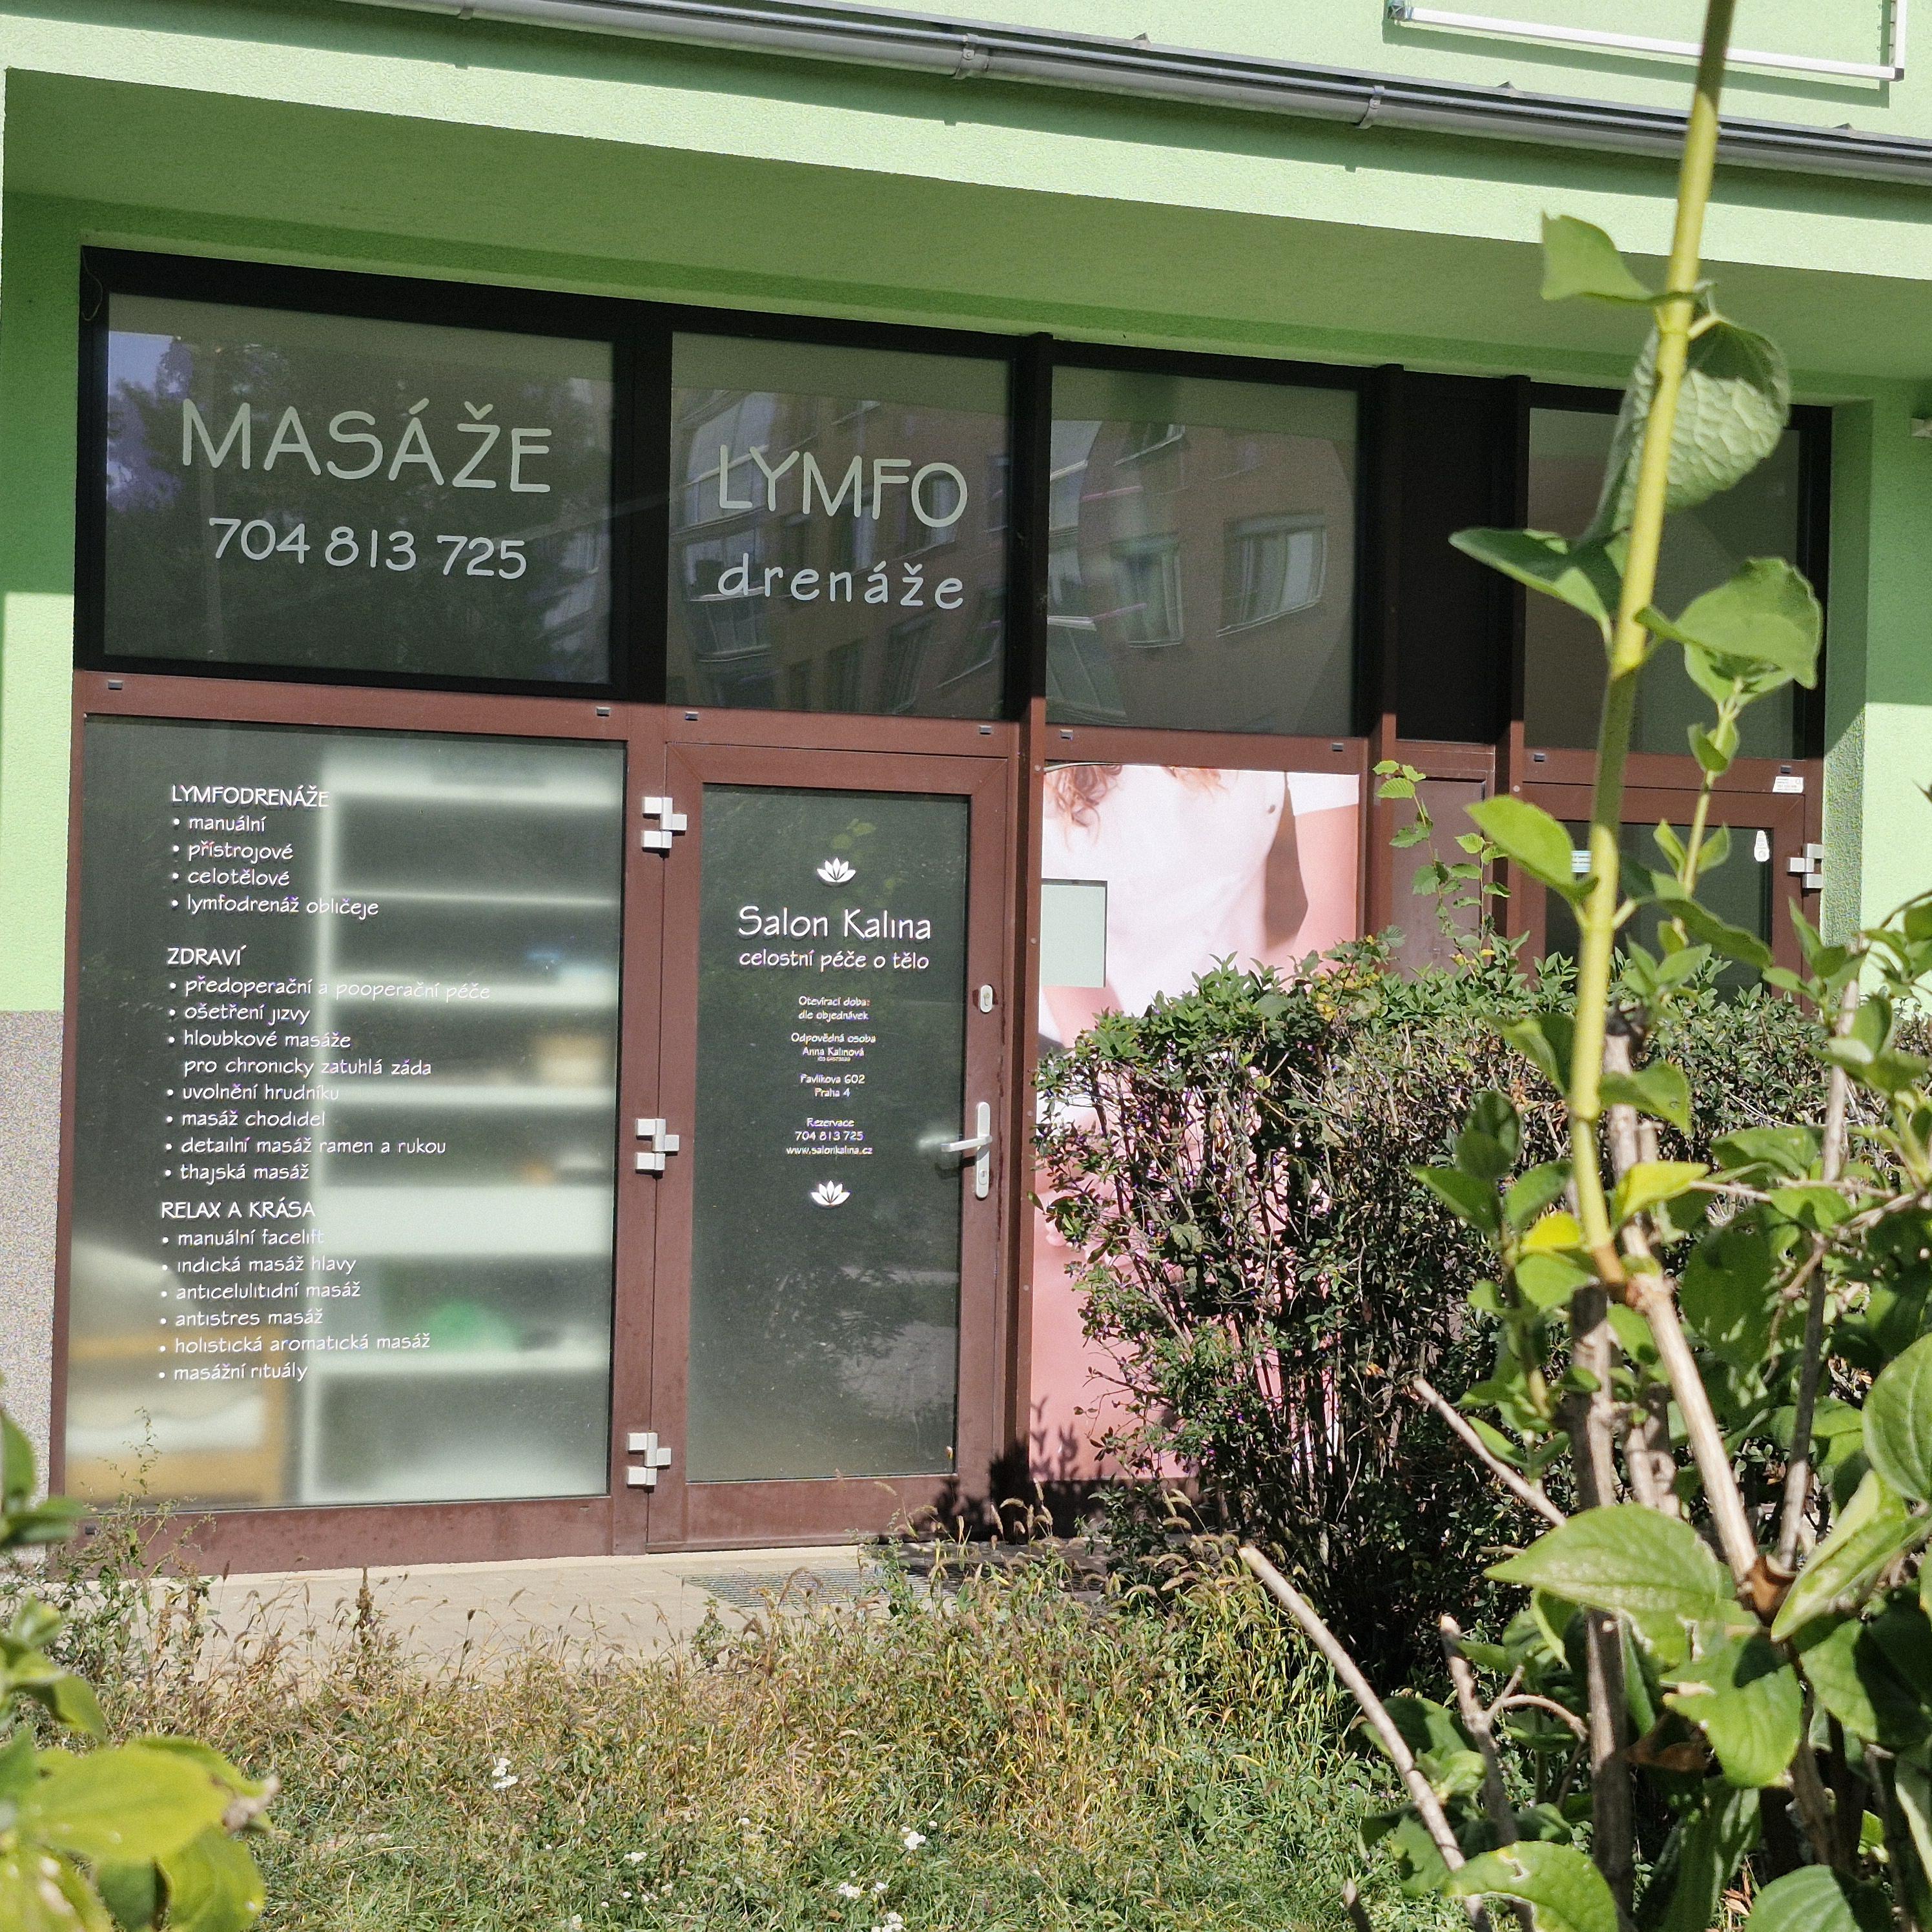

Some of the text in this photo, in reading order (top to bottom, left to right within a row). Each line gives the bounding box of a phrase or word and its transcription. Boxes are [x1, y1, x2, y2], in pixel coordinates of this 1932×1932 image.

[183, 398, 551, 492] MASÁŽE
[719, 445, 967, 528] LYMFO
[209, 517, 526, 579] 704 813 725
[718, 553, 963, 609] drenáže
[172, 785, 329, 807] LYMFODRENÁŽE
[189, 816, 267, 832] manuální
[188, 840, 293, 864] přístrojové
[188, 868, 289, 886] celotělové
[188, 894, 378, 920] lymfodrenáž obličeje
[739, 905, 931, 940] Salon Kalina
[167, 945, 247, 966] ZDRAVÍ
[739, 948, 930, 973] celostní péče o tělo
[185, 975, 491, 1003] předoperační a pooperační péče
[185, 1003, 310, 1026] ošetření jizvy
[798, 1009, 870, 1022] dle objednávek
[184, 1030, 351, 1049] hloubkové masáže
[791, 1033, 876, 1046] Odpovědná osoba
[802, 1047, 865, 1056] Anna Kalinová
[184, 1057, 431, 1079] pro chronicky zatuhlá záda
[844, 1074, 865, 1084] 602
[183, 1084, 339, 1101] uvolnění hrudníku
[814, 1087, 851, 1097] Praha 4
[181, 1110, 325, 1127] masáž chodidel
[807, 1118, 855, 1127] Rezervace
[181, 1136, 446, 1155] detailní masáž ramen a rukou
[795, 1131, 865, 1141] 704 813 725
[181, 1164, 310, 1186] thajská masáž
[161, 1197, 316, 1219] RELAX A KRÁSA
[178, 1229, 324, 1246] manuální facelift
[178, 1255, 356, 1275] indická masáž hlavy
[306, 1281, 361, 1298] masáž
[175, 1308, 324, 1327] antistres masáž
[175, 1332, 431, 1353] holistická aromatická masáž
[174, 1362, 308, 1382] masážní rituály
